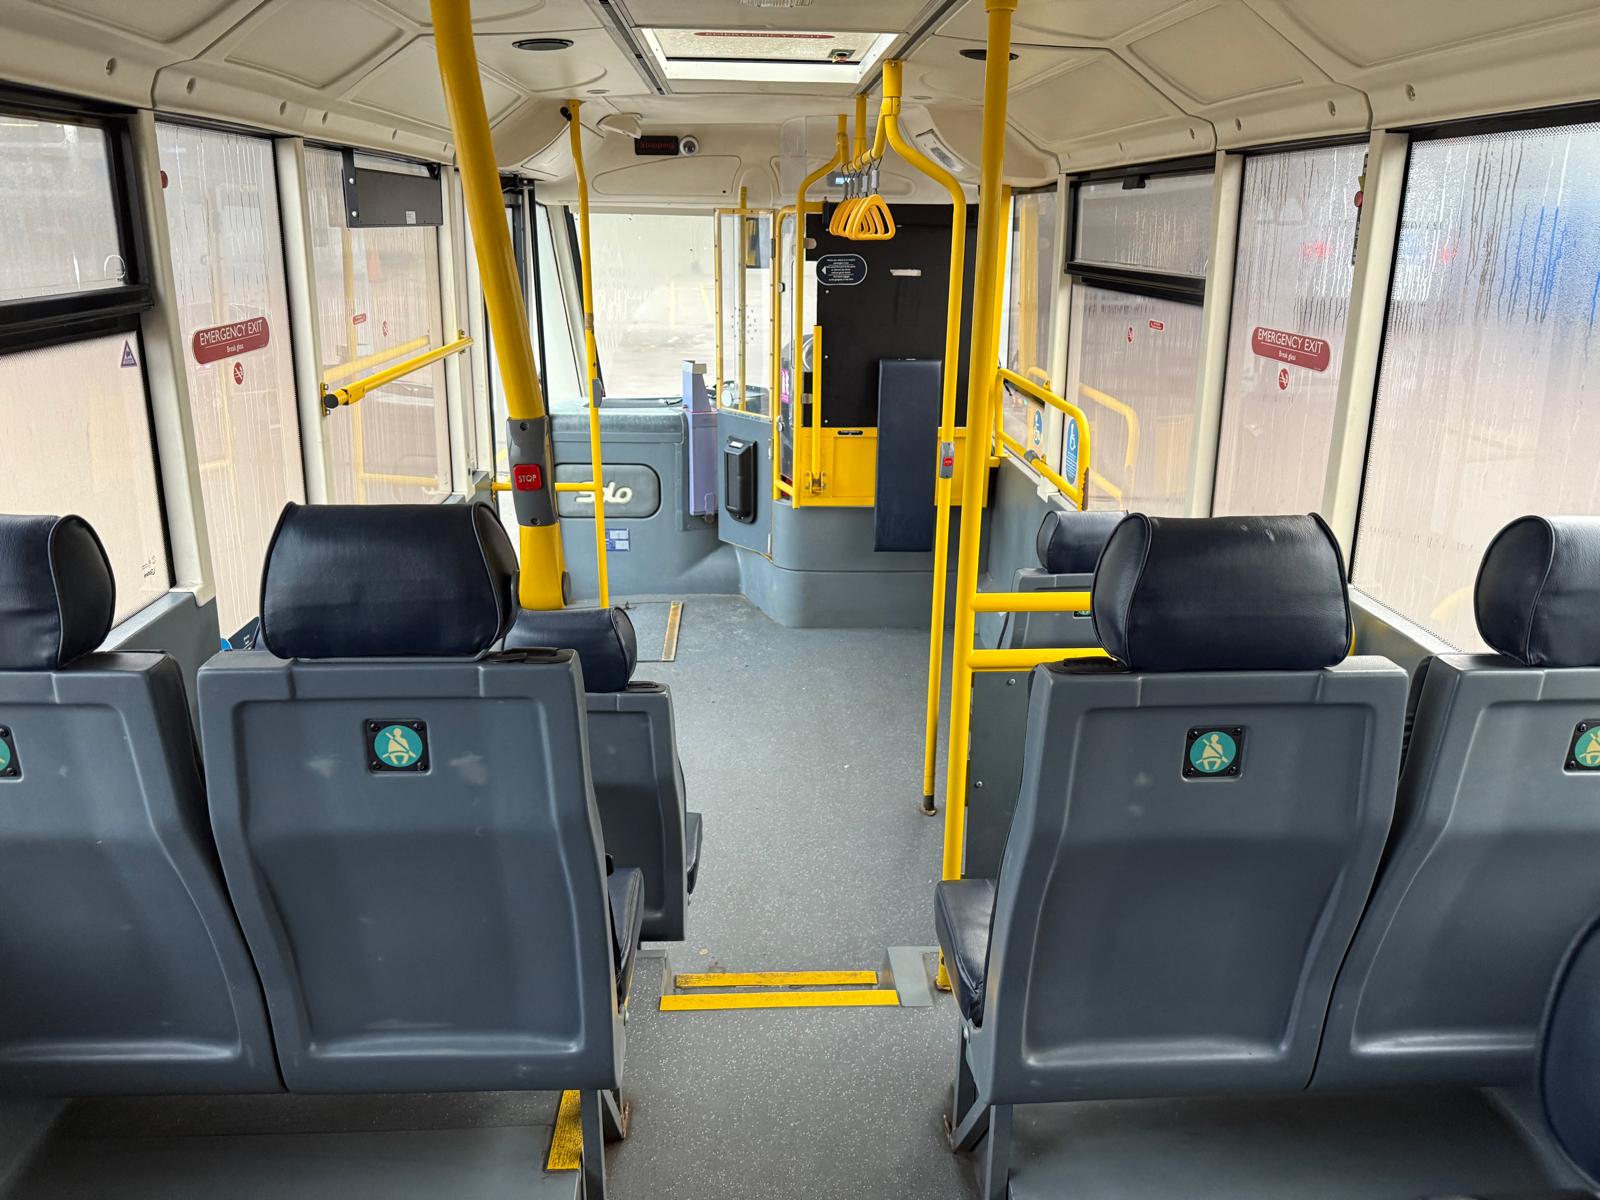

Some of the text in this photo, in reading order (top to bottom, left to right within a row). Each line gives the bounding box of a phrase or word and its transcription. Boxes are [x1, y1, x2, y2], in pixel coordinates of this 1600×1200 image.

[199, 320, 263, 346] EMERGENCY EXIT
[1257, 329, 1324, 354] EMERGENCY EXIT
[518, 474, 537, 483] STOP
